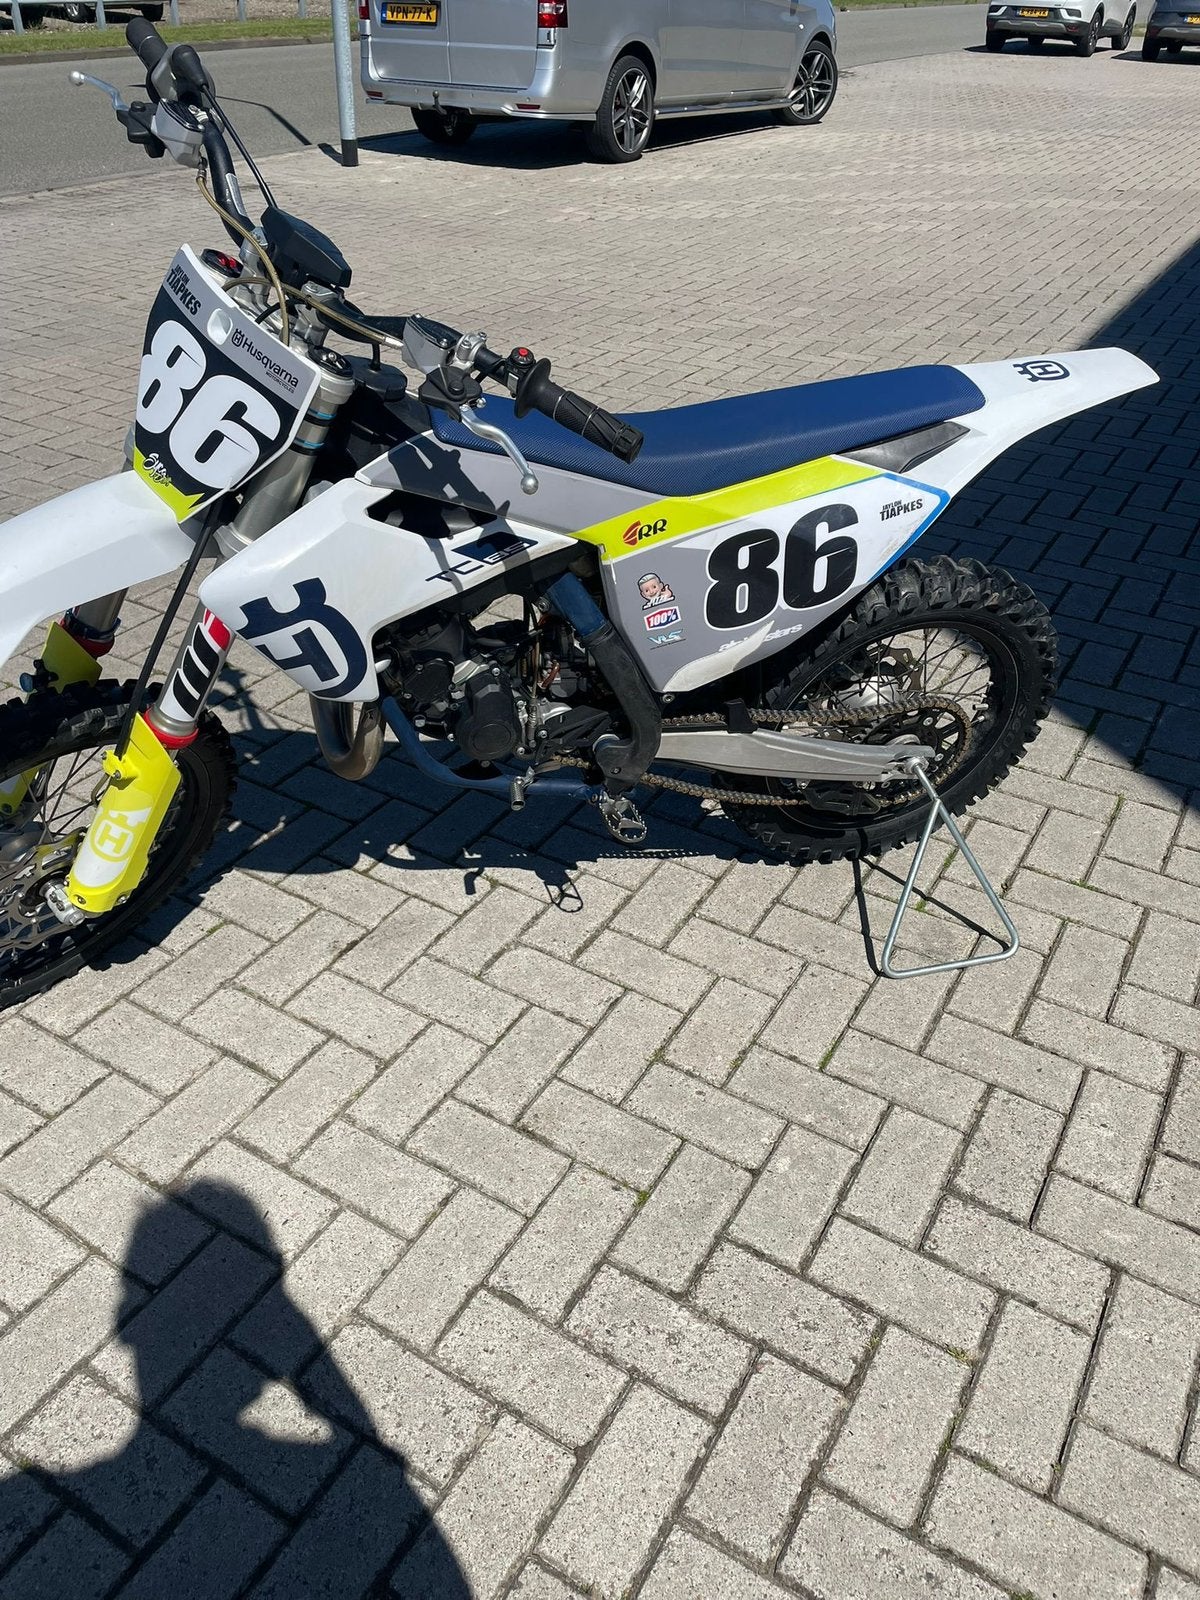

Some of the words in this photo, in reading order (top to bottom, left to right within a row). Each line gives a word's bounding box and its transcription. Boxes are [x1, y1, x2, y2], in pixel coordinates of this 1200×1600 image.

[390, 6, 432, 20] VPN-77-K
[166, 268, 202, 315] TJAPKES
[242, 337, 299, 388] Husqvarna
[136, 319, 281, 489] 86
[880, 498, 923, 521] TJAPKES
[704, 503, 859, 630] 86
[648, 608, 677, 628] 100%
